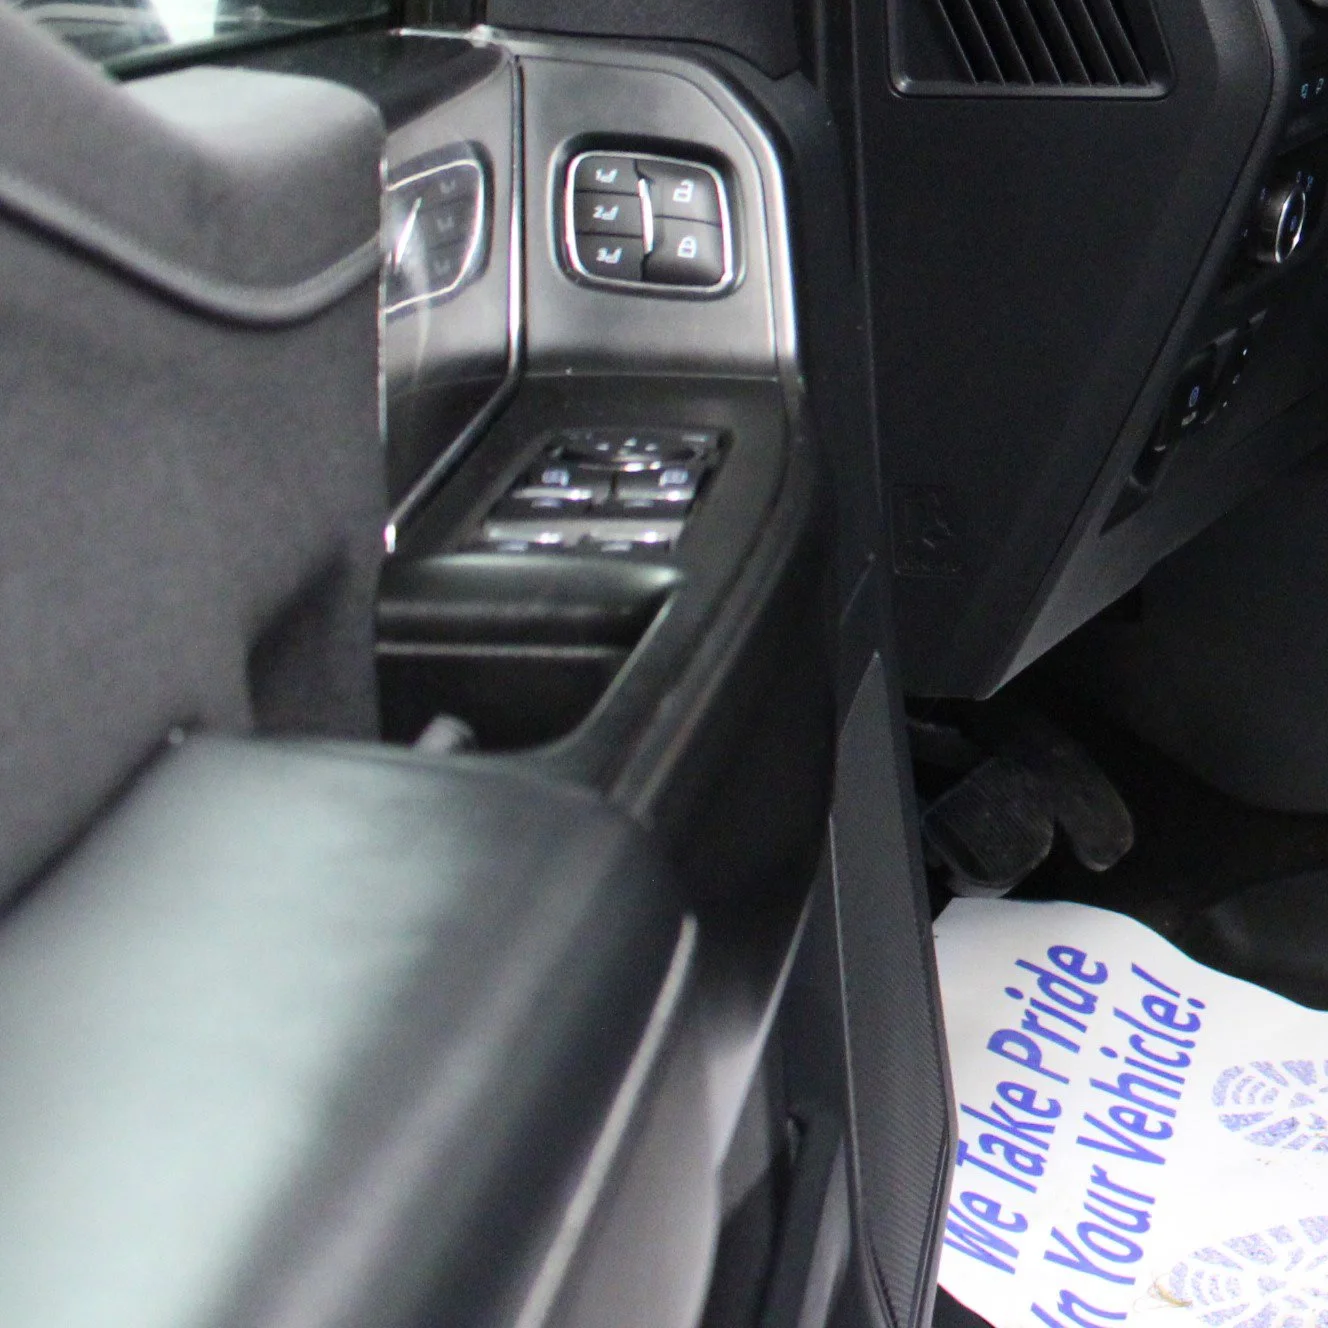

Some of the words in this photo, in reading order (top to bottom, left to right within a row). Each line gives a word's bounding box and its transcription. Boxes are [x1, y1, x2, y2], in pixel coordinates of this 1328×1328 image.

[986, 944, 1109, 1086] Pride
[1076, 961, 1207, 1166] Vehicle!
[953, 1080, 1063, 1194] Take
[943, 1190, 1029, 1275] We
[1043, 1163, 1156, 1286] Your
